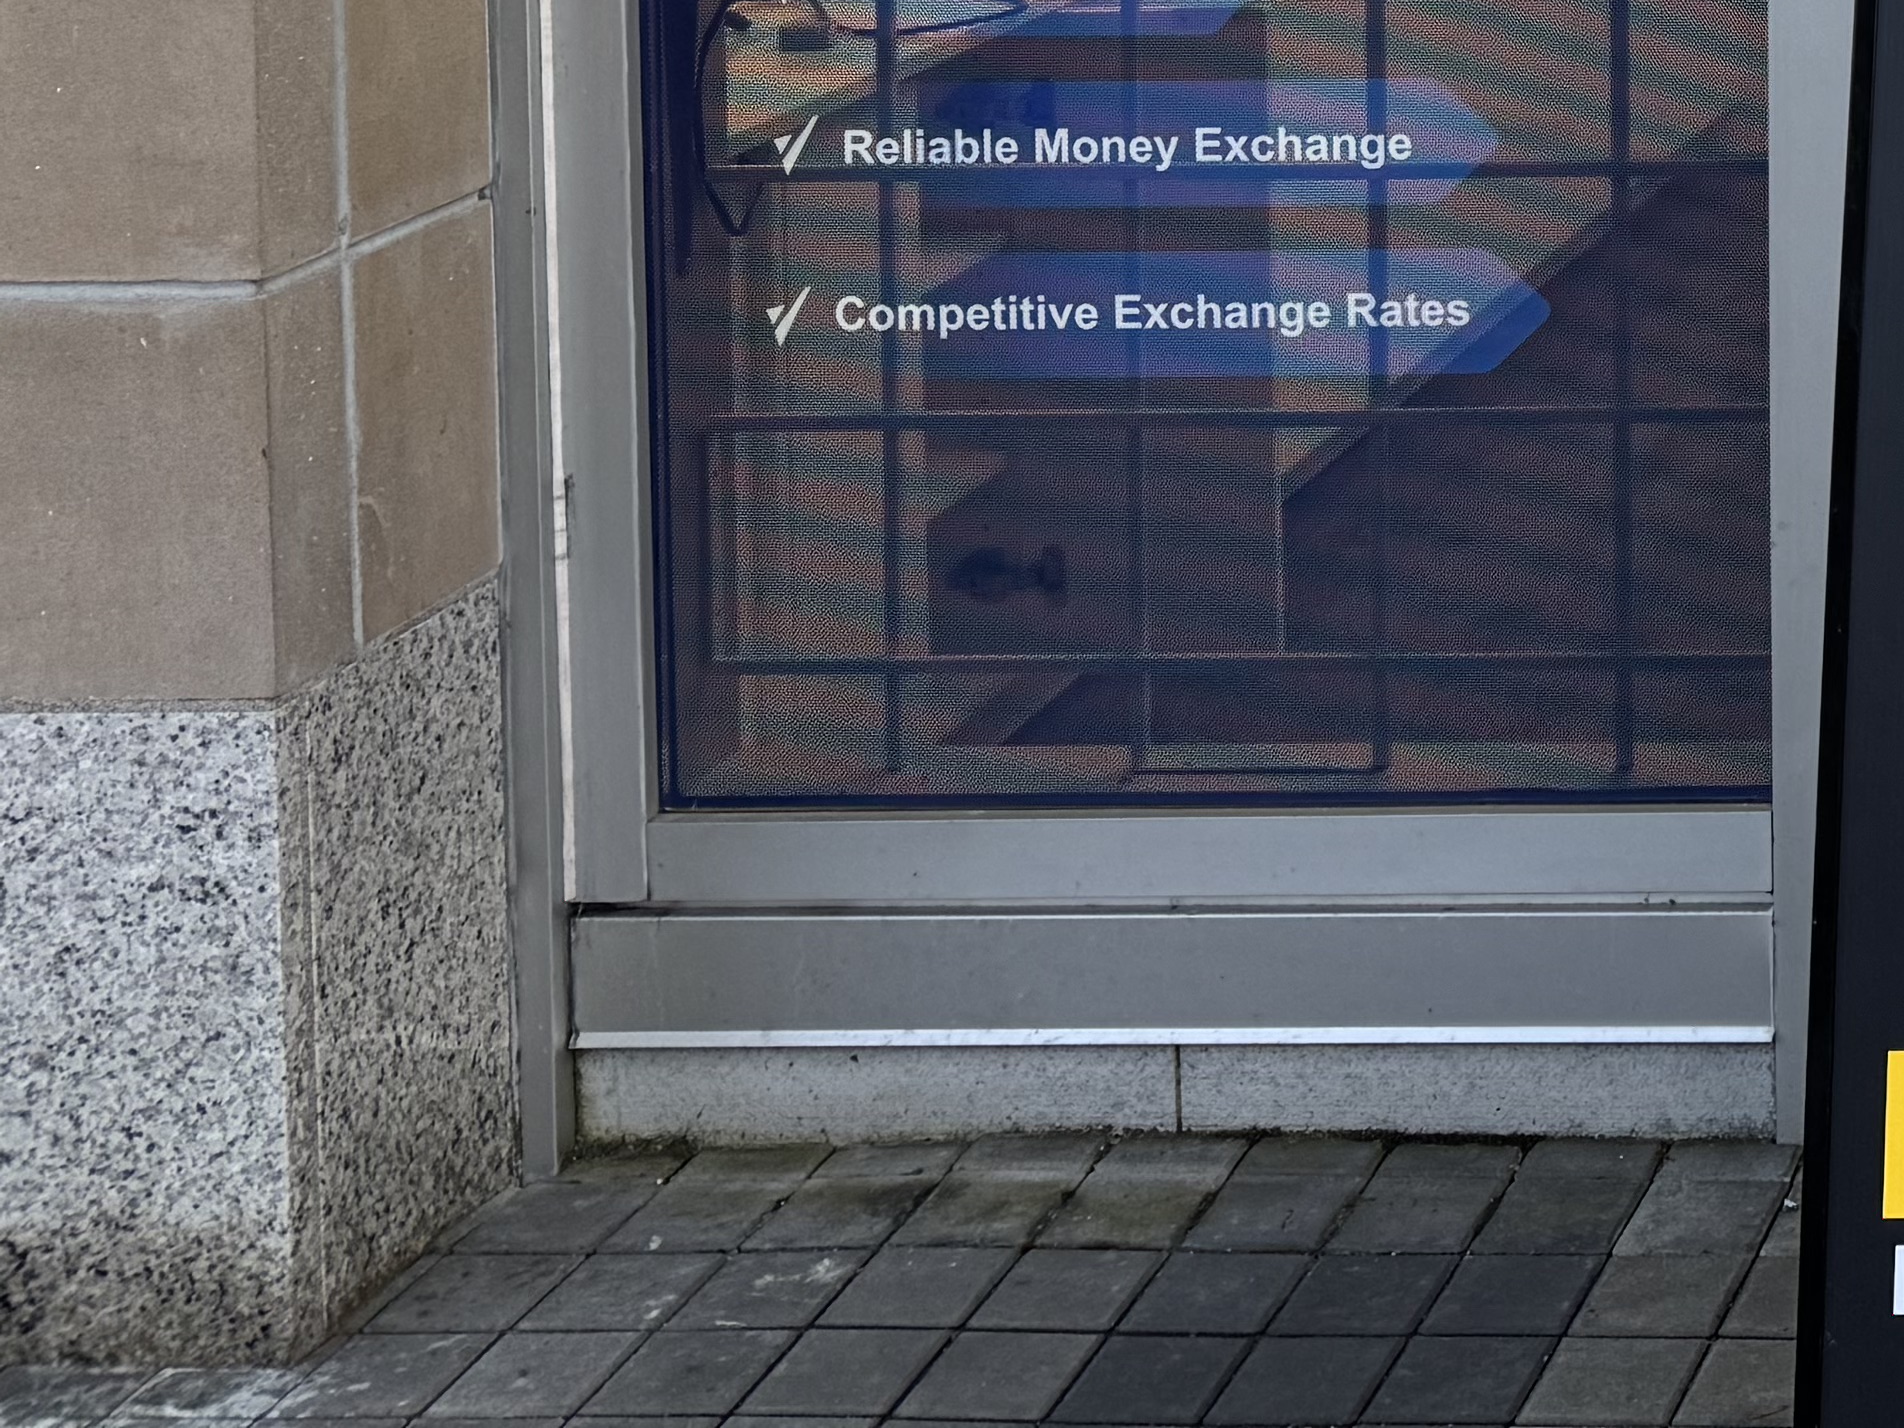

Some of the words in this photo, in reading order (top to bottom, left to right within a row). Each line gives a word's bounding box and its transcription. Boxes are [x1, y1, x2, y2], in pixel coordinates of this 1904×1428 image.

[843, 128, 1019, 165] Reliable
[1034, 128, 1178, 172] Money
[1195, 127, 1413, 168] Exchange
[834, 294, 1099, 339] Competitive
[1115, 294, 1331, 335] Exchange
[1348, 292, 1471, 329] Rates
